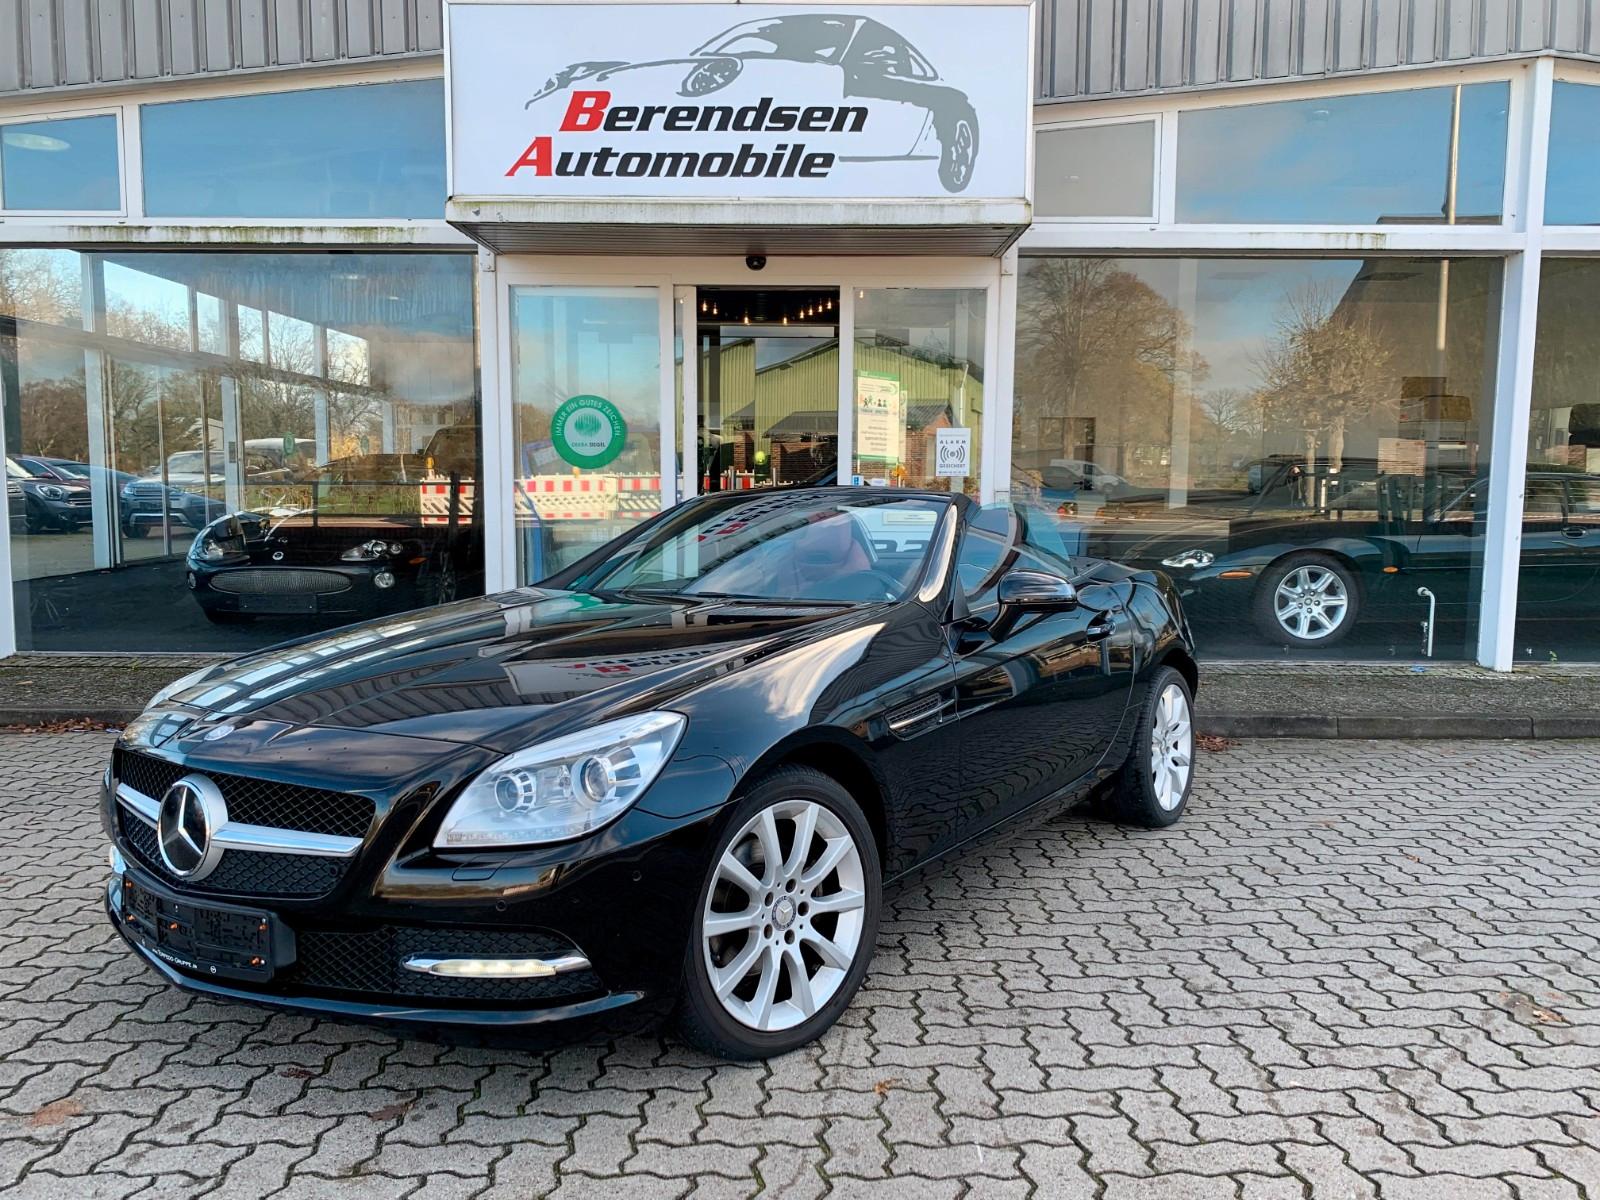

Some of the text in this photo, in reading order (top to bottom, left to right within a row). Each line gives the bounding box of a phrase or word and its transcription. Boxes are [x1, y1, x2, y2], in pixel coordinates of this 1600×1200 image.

[559, 91, 869, 132] Berendsen
[504, 136, 837, 178] Automobile
[556, 400, 621, 436] IMMER EIN GUTES ZEICHEN
